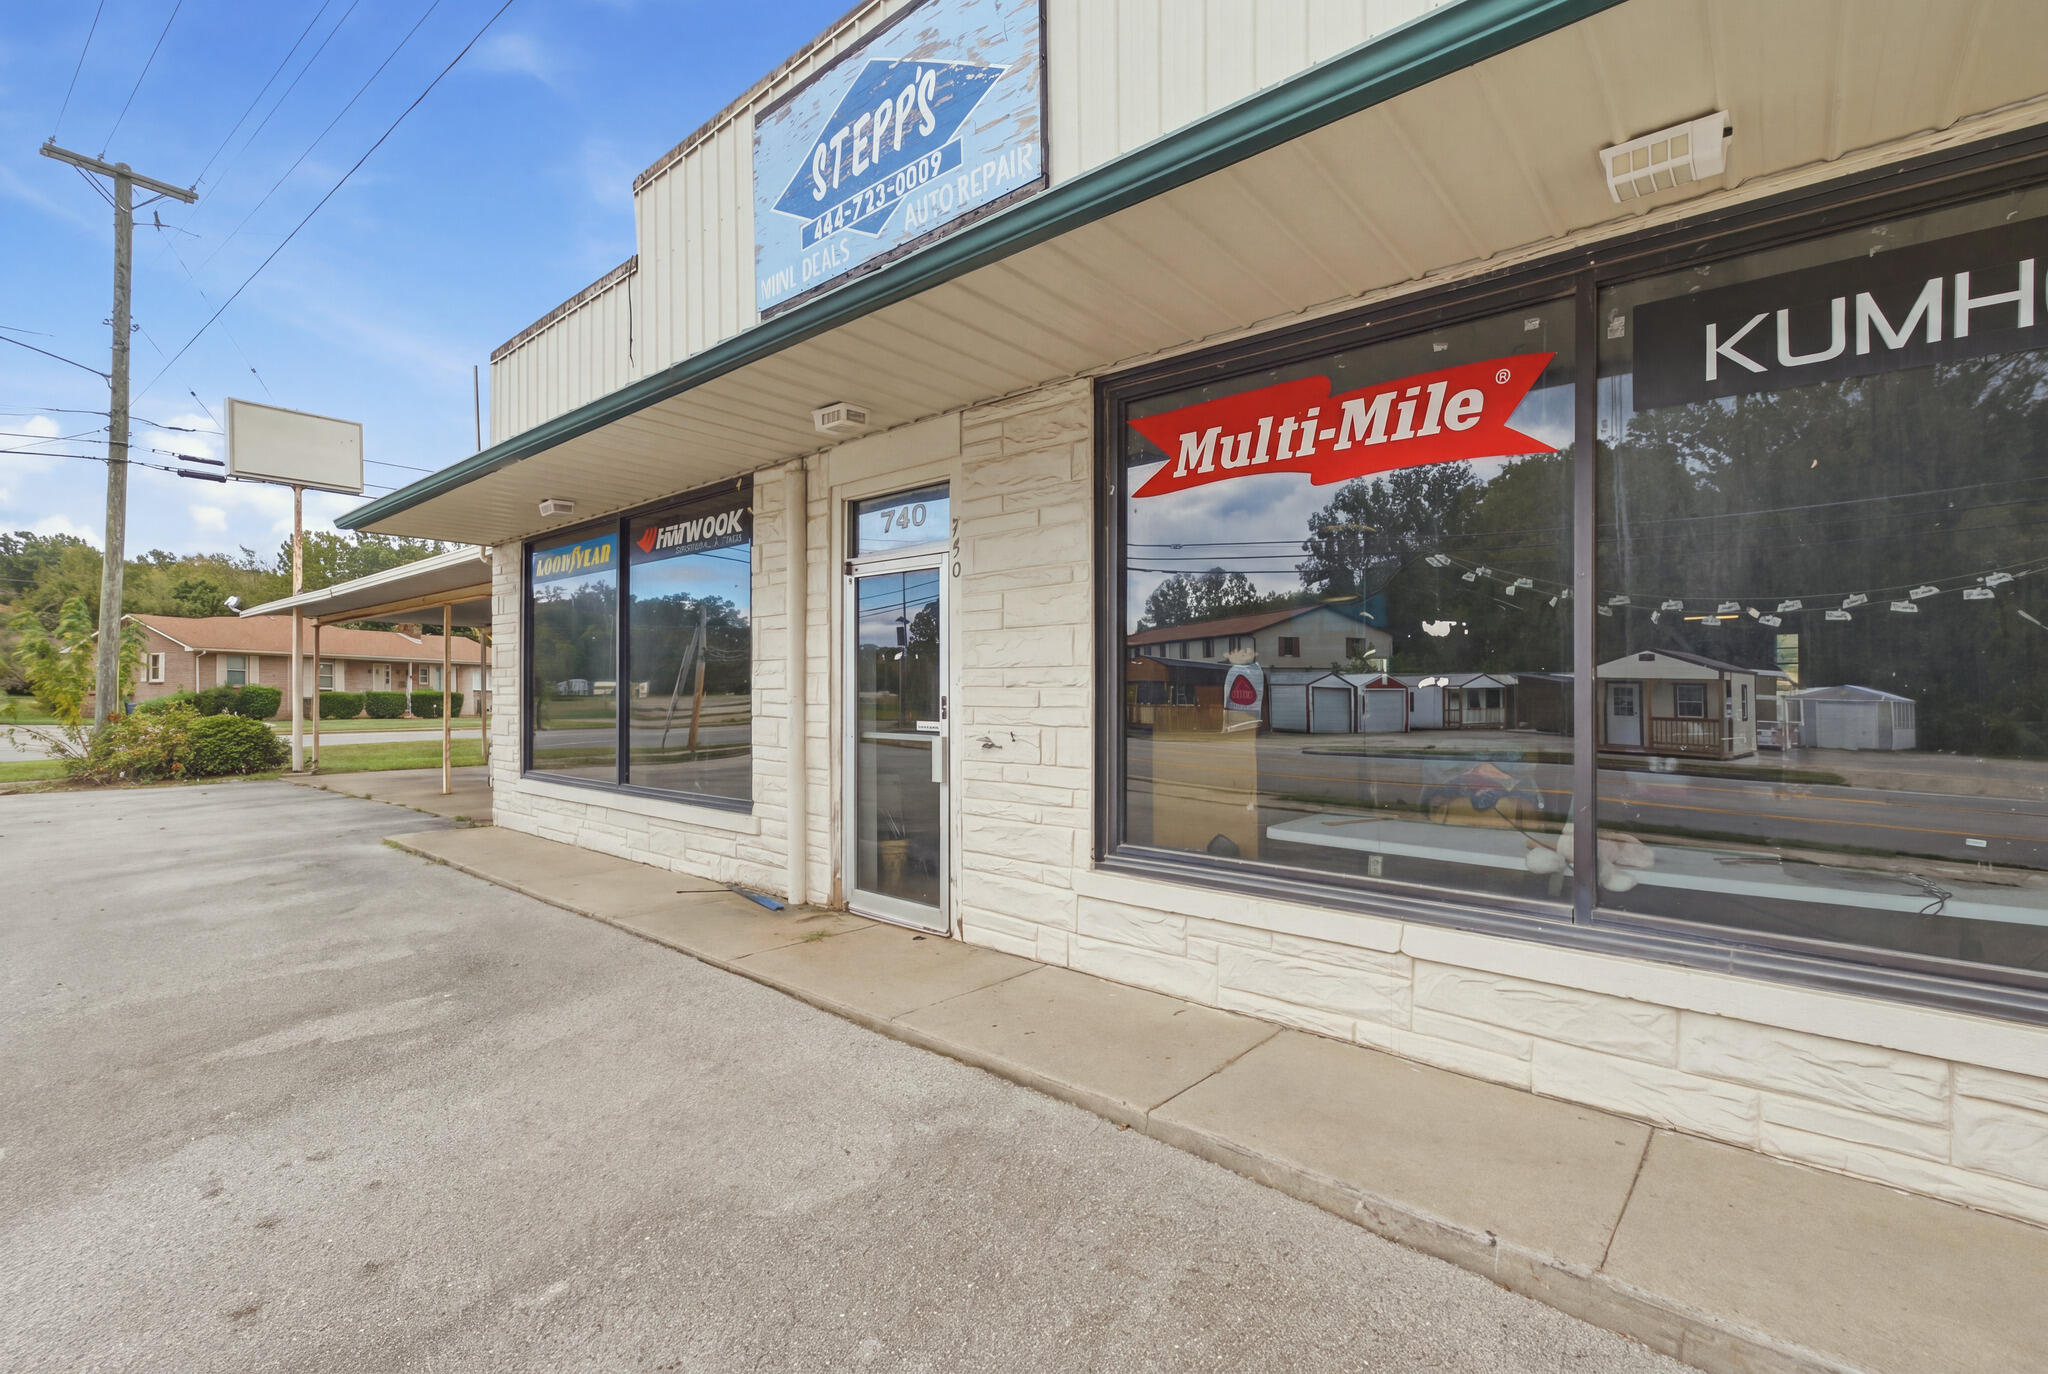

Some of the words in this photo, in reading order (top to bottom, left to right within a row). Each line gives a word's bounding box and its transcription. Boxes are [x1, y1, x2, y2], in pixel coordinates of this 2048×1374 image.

[811, 65, 936, 201] STEPP'S
[802, 238, 850, 283] DEALS
[904, 183, 953, 231] AUTO
[957, 143, 1033, 204] REPAIR
[813, 151, 942, 240] 444-723-0009
[1705, 257, 2048, 382] KUMH
[1172, 380, 1485, 478] Multi-Mile
[880, 503, 927, 533] 740
